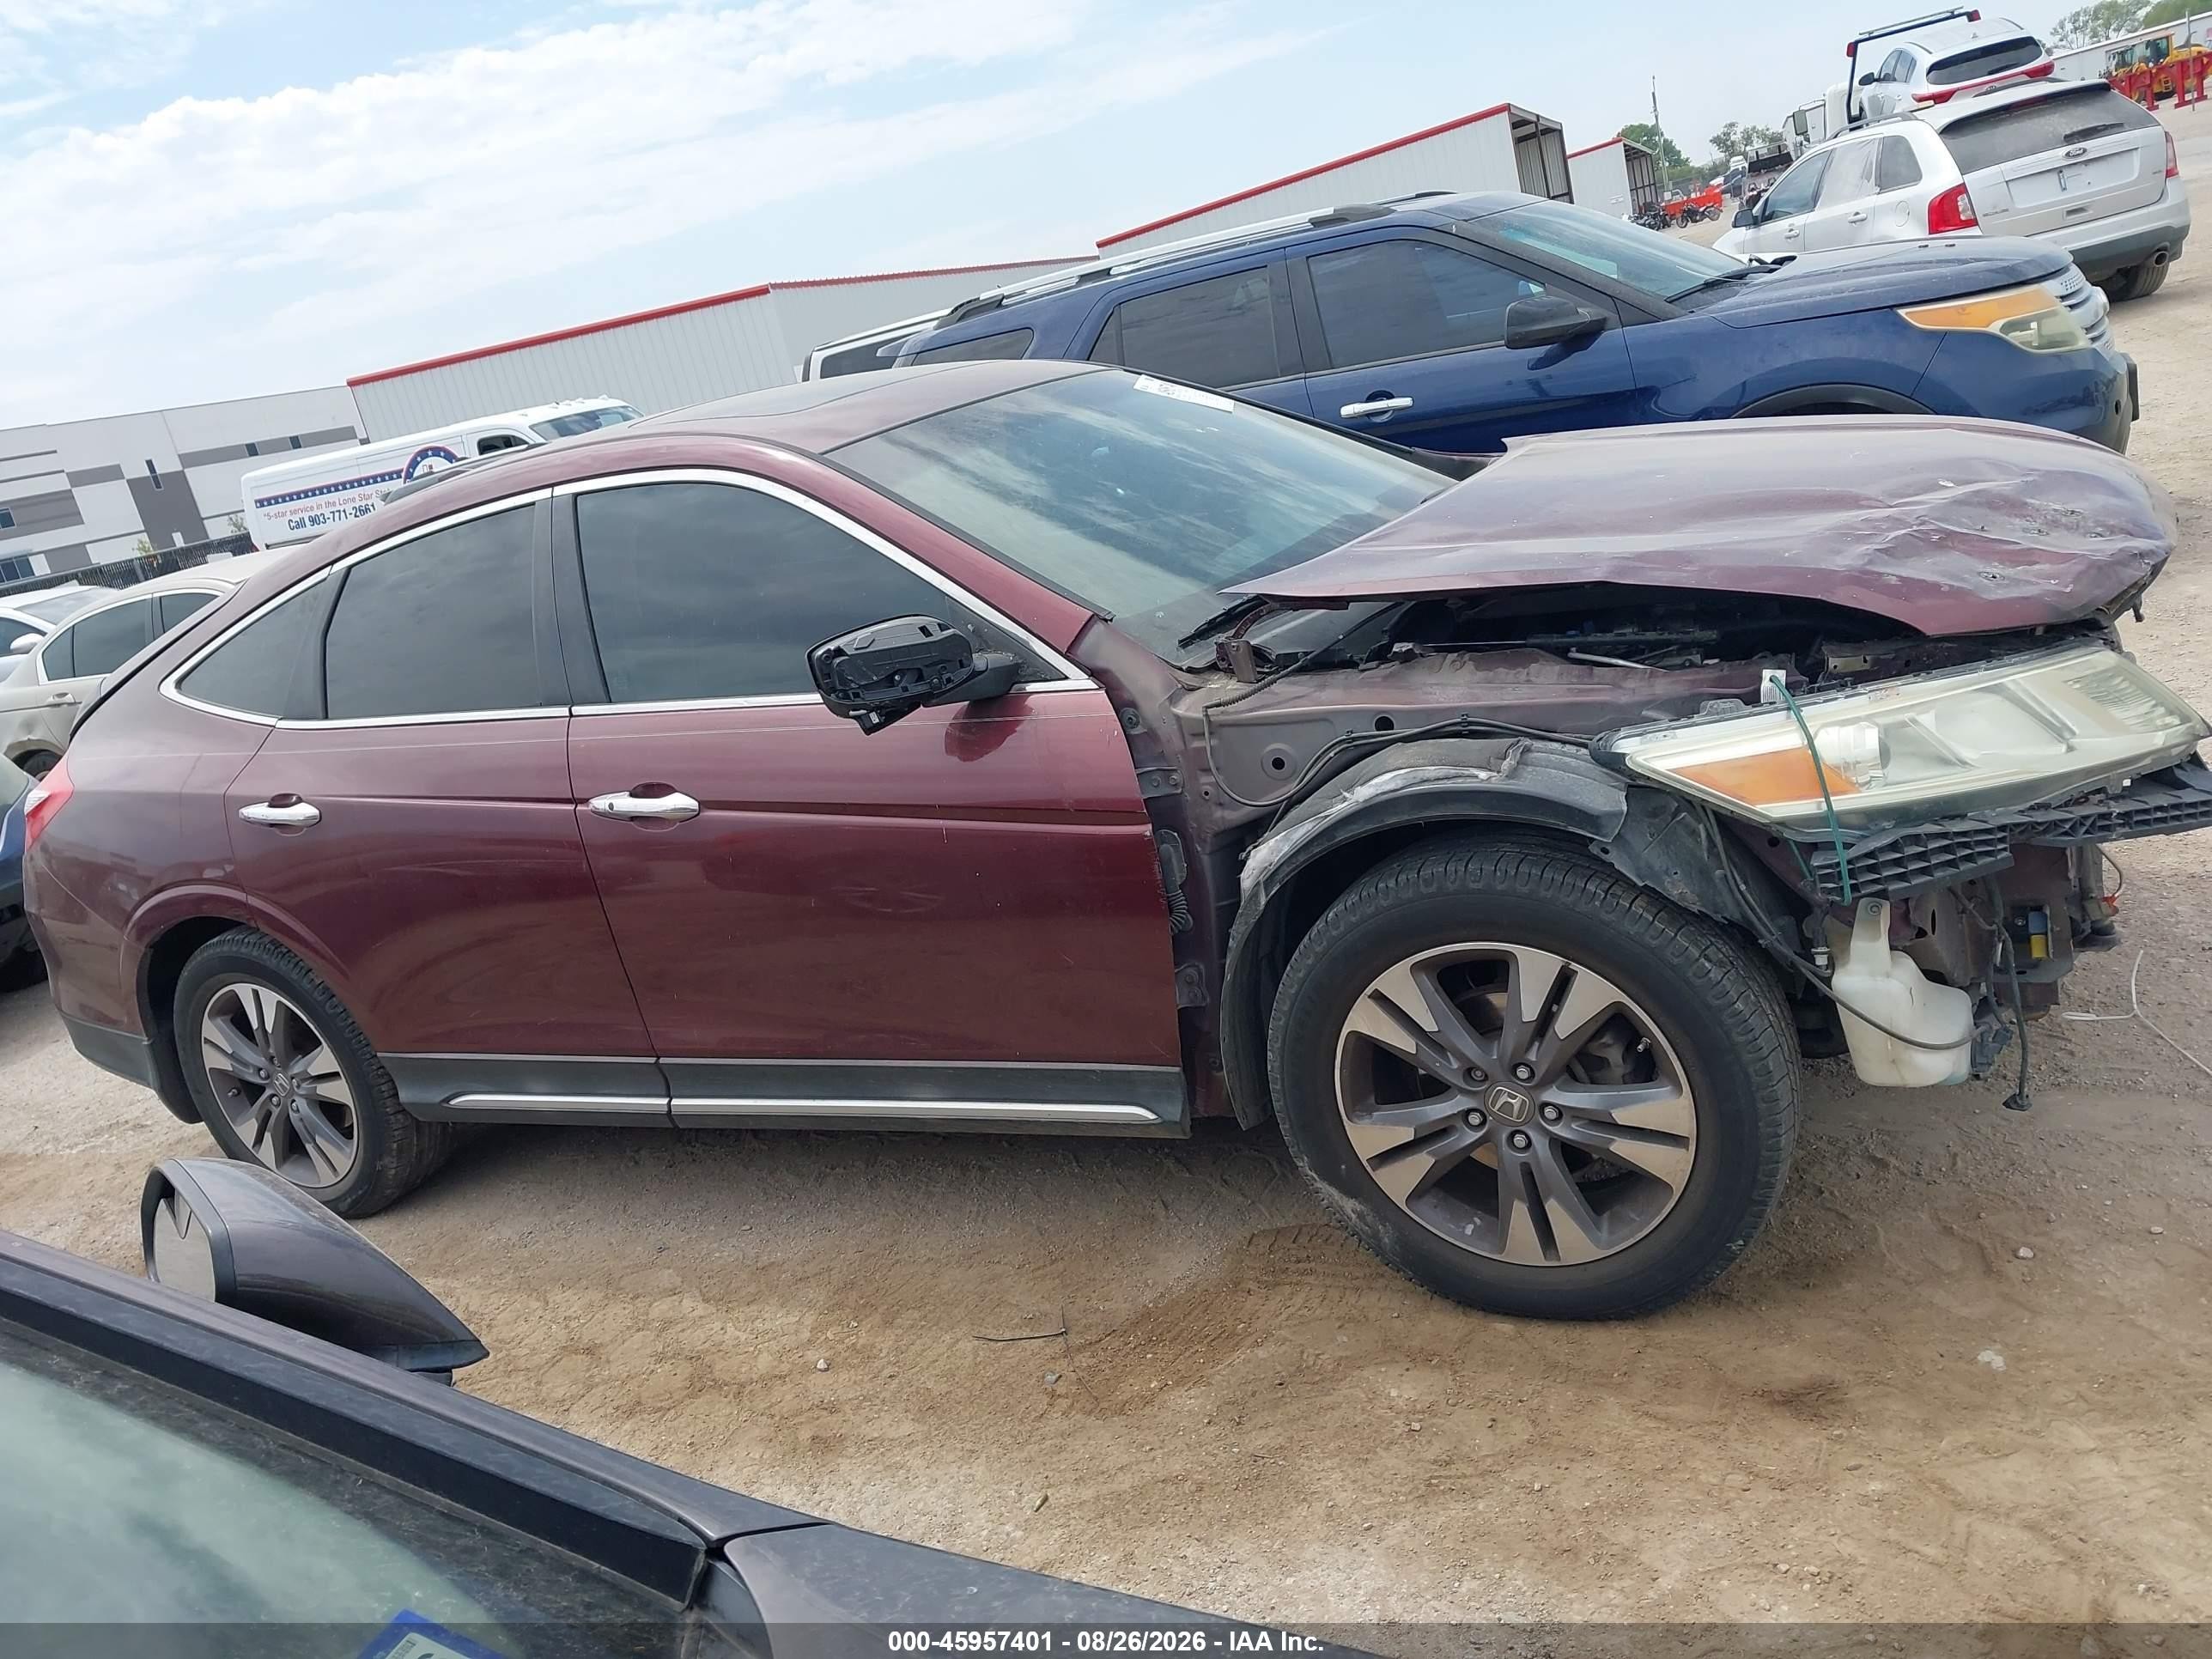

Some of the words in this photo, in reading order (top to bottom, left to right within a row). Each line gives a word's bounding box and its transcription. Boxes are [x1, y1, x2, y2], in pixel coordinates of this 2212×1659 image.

[288, 517, 307, 531] Call
[308, 501, 376, 526] 903-771-2661
[289, 505, 314, 516] service
[316, 501, 323, 510] in
[325, 500, 337, 510] the
[338, 495, 356, 506] Lone
[358, 491, 374, 501] Star
